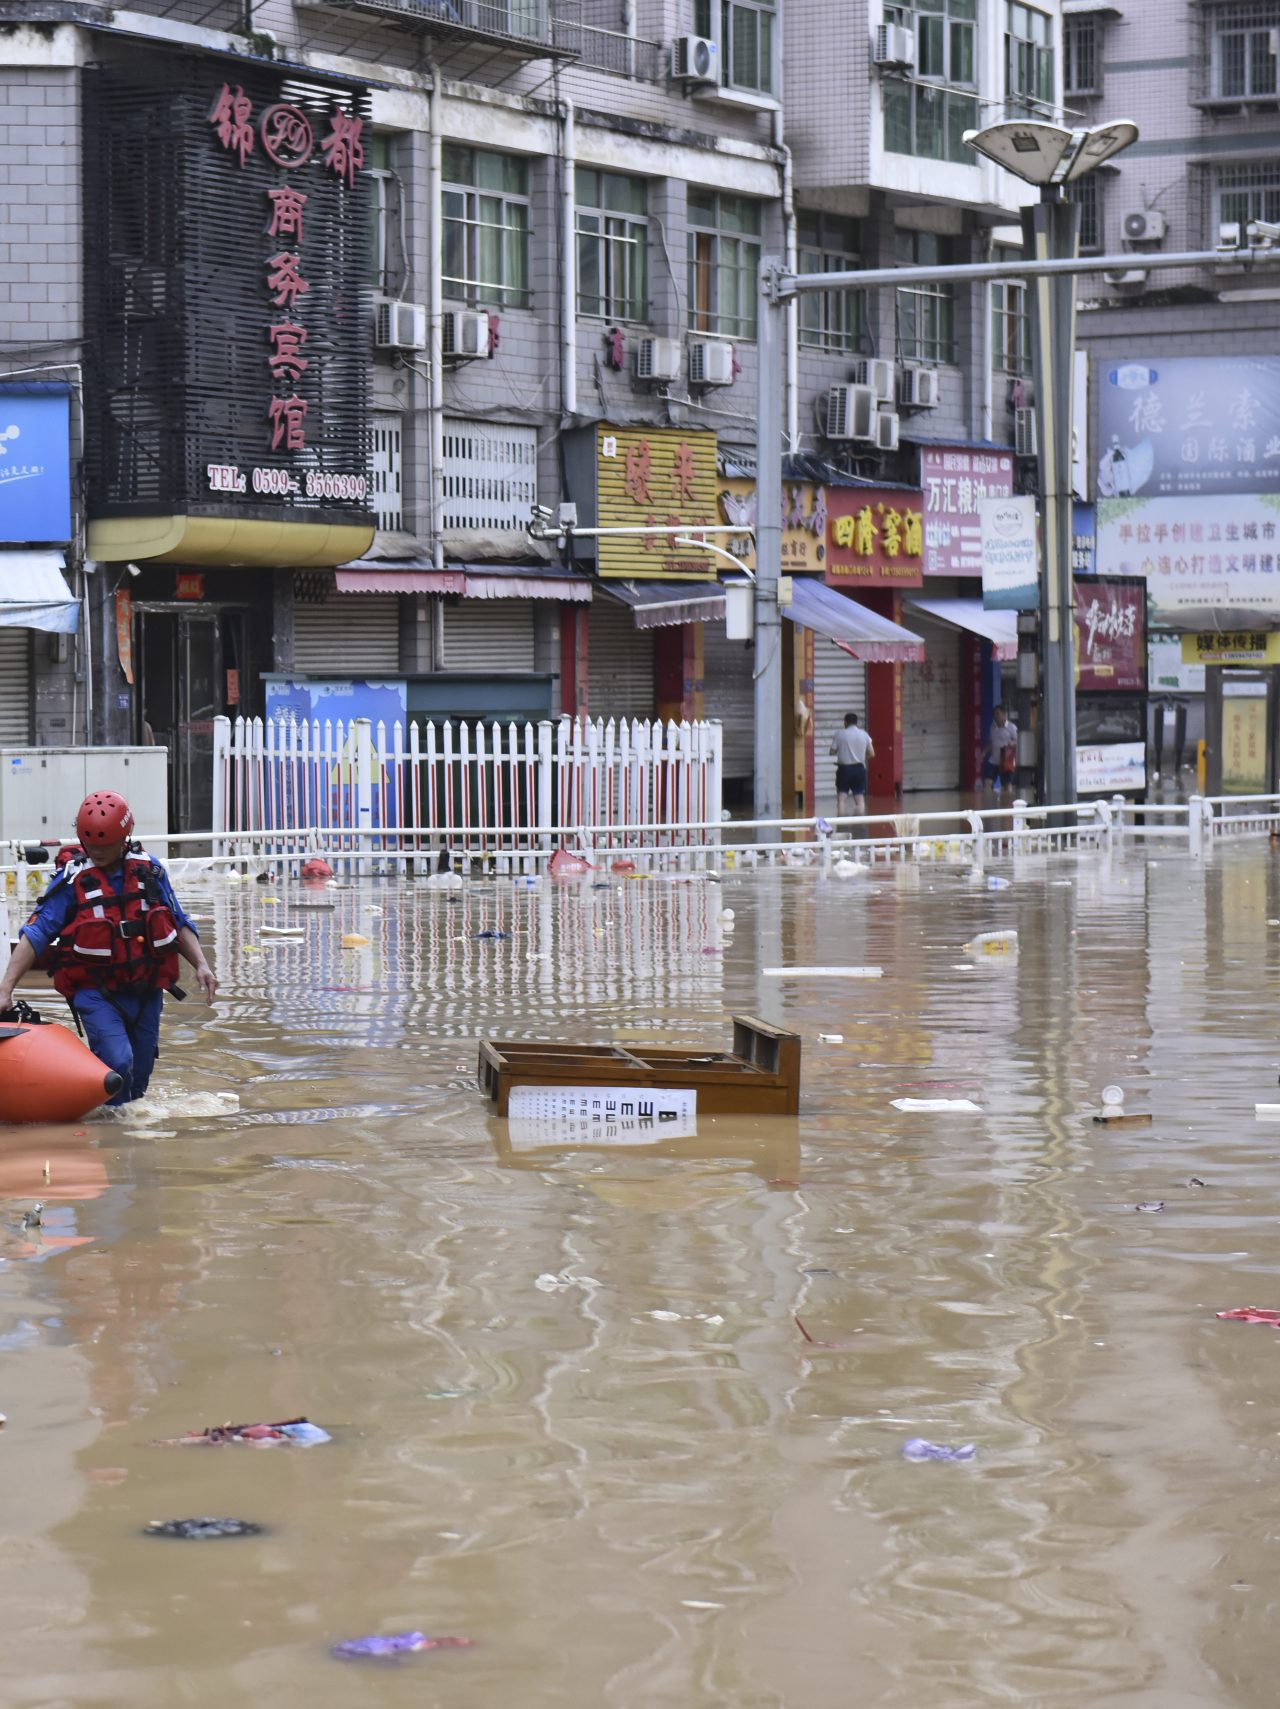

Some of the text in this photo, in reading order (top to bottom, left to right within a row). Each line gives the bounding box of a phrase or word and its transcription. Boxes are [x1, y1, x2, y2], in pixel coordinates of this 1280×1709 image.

[210, 83, 255, 168] 锦
[321, 107, 364, 190] 都
[267, 185, 310, 452] 商务宾馆
[1119, 521, 1276, 544] 手拉手创建卫生城市
